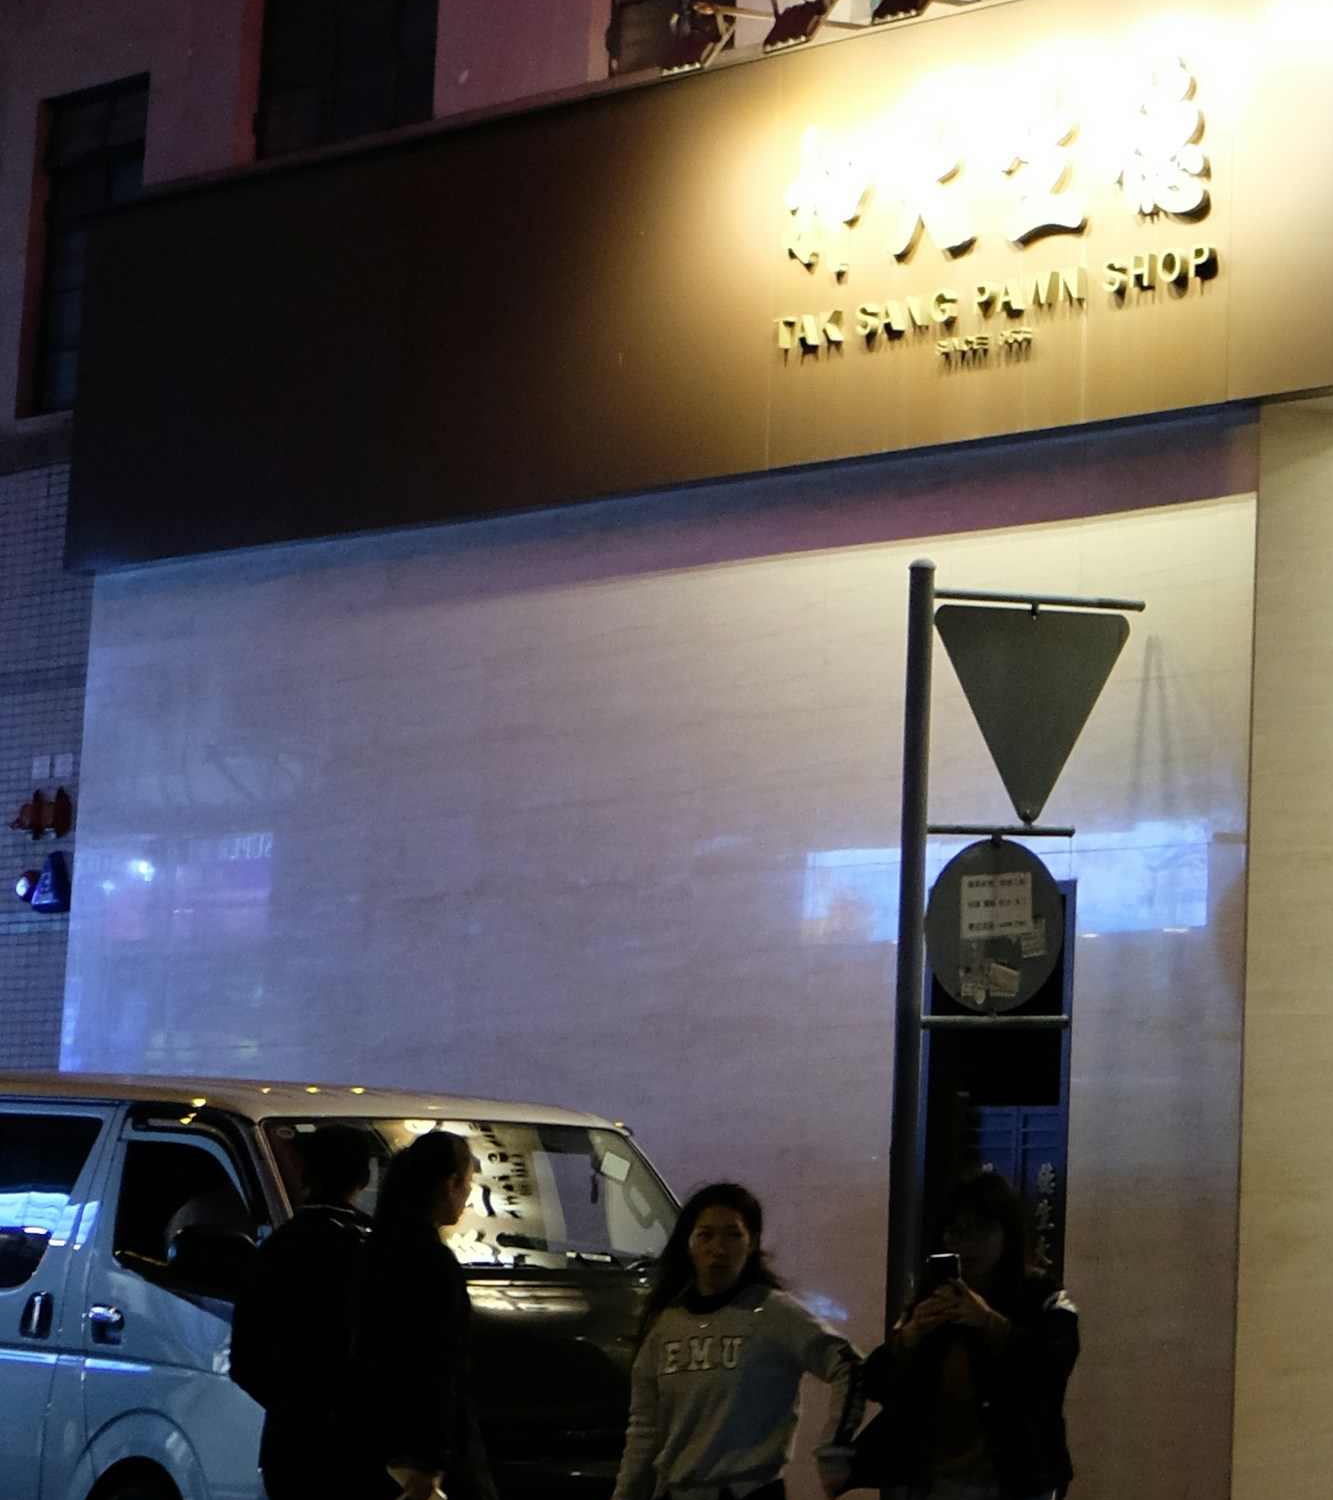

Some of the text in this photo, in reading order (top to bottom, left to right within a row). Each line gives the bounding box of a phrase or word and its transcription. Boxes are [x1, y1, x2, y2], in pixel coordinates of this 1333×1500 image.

[774, 243, 1218, 350] TAK SANG PAWN SHOP
[660, 1335, 744, 1375] EMU
